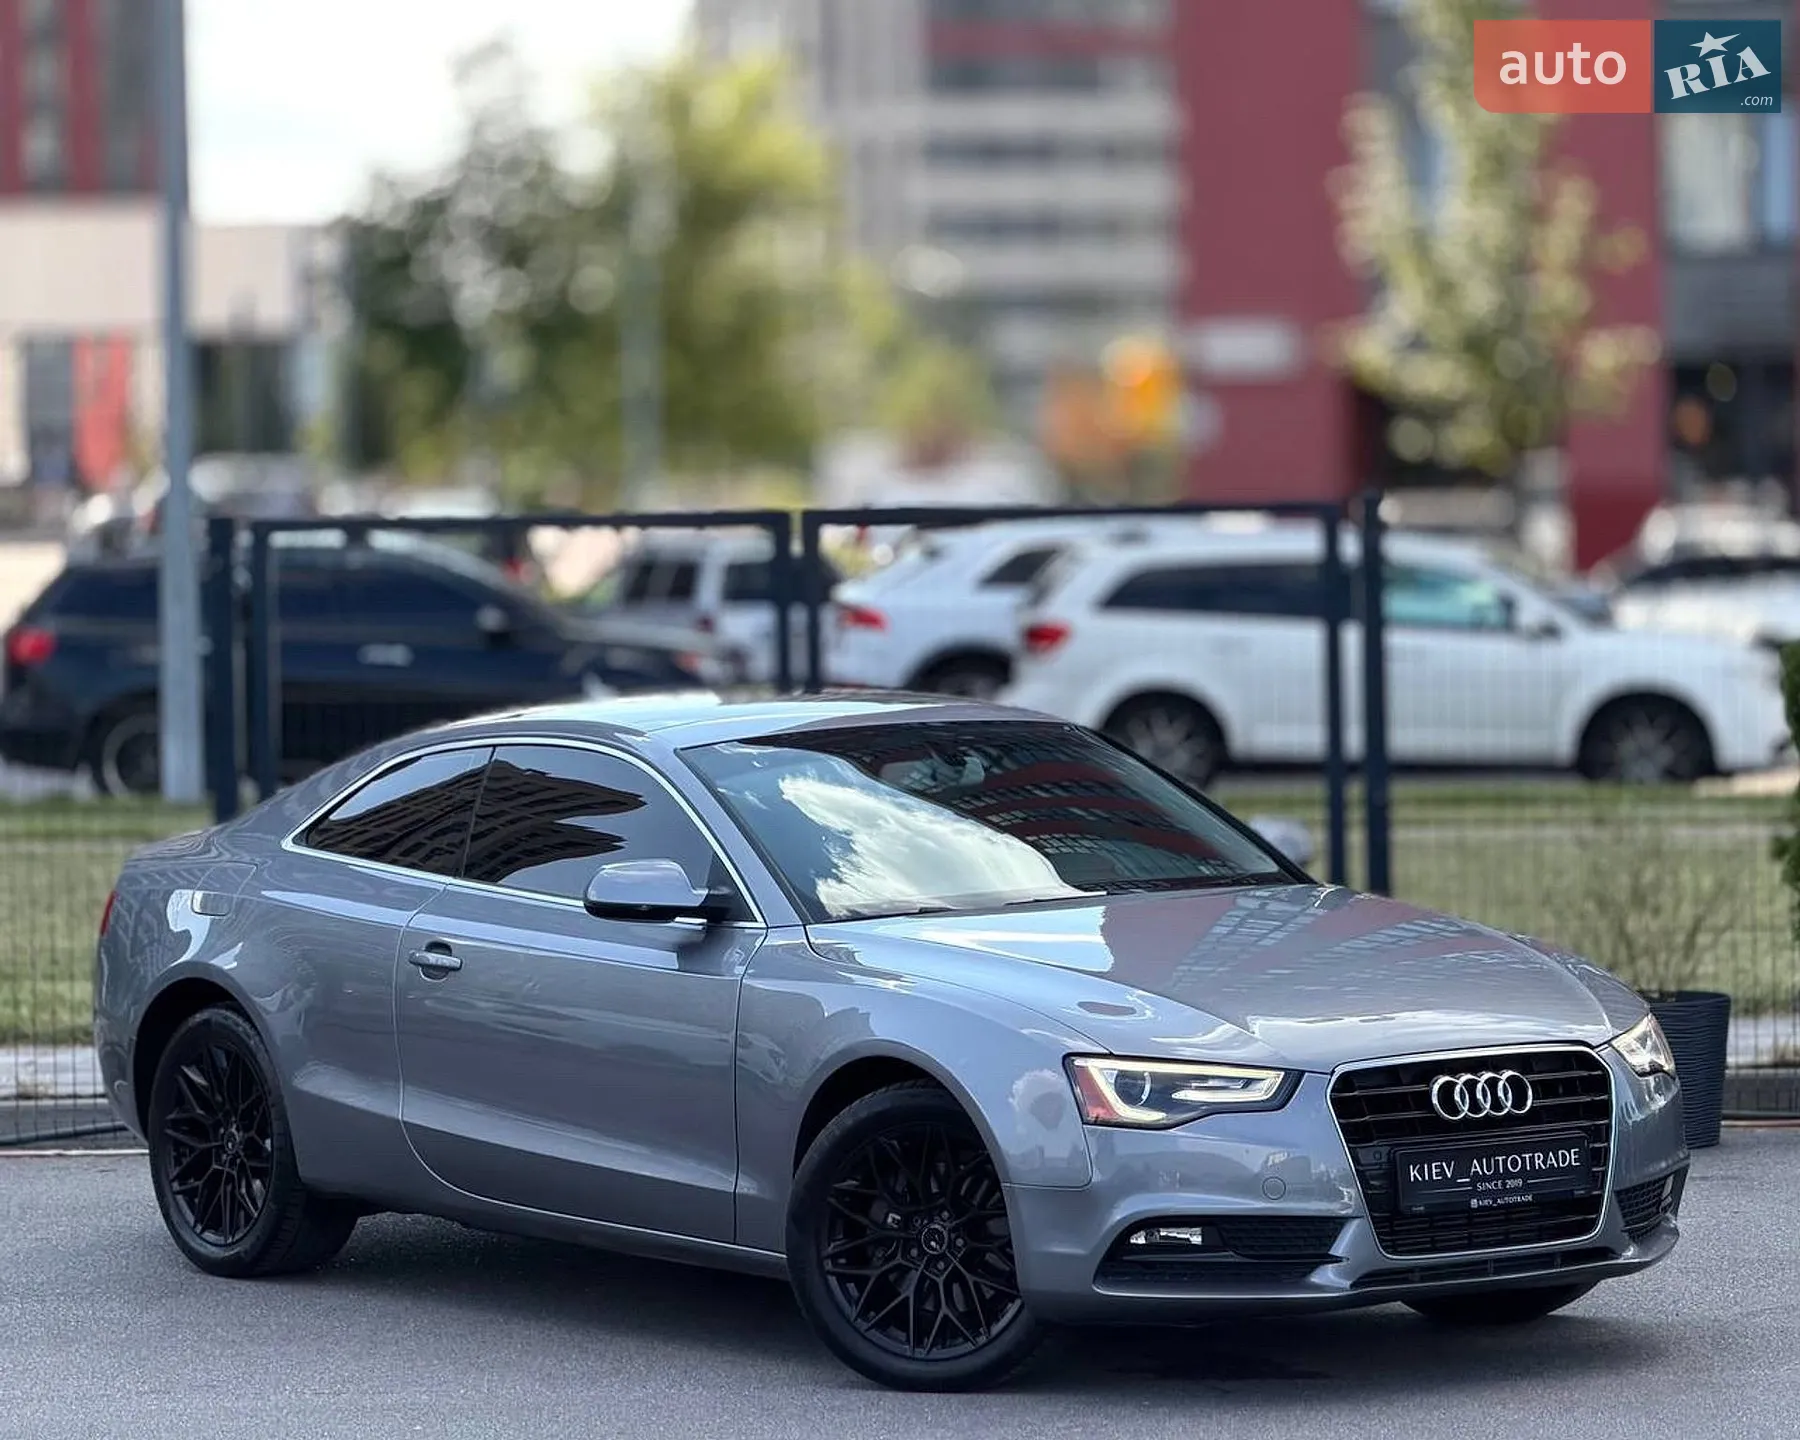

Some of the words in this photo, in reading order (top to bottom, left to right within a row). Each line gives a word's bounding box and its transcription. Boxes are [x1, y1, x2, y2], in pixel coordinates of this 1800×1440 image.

[1409, 1148, 1581, 1183] KIEV_AUTOTRADE
[1476, 1181, 1503, 1191] SINCE
[1505, 1178, 1523, 1189] 2019
